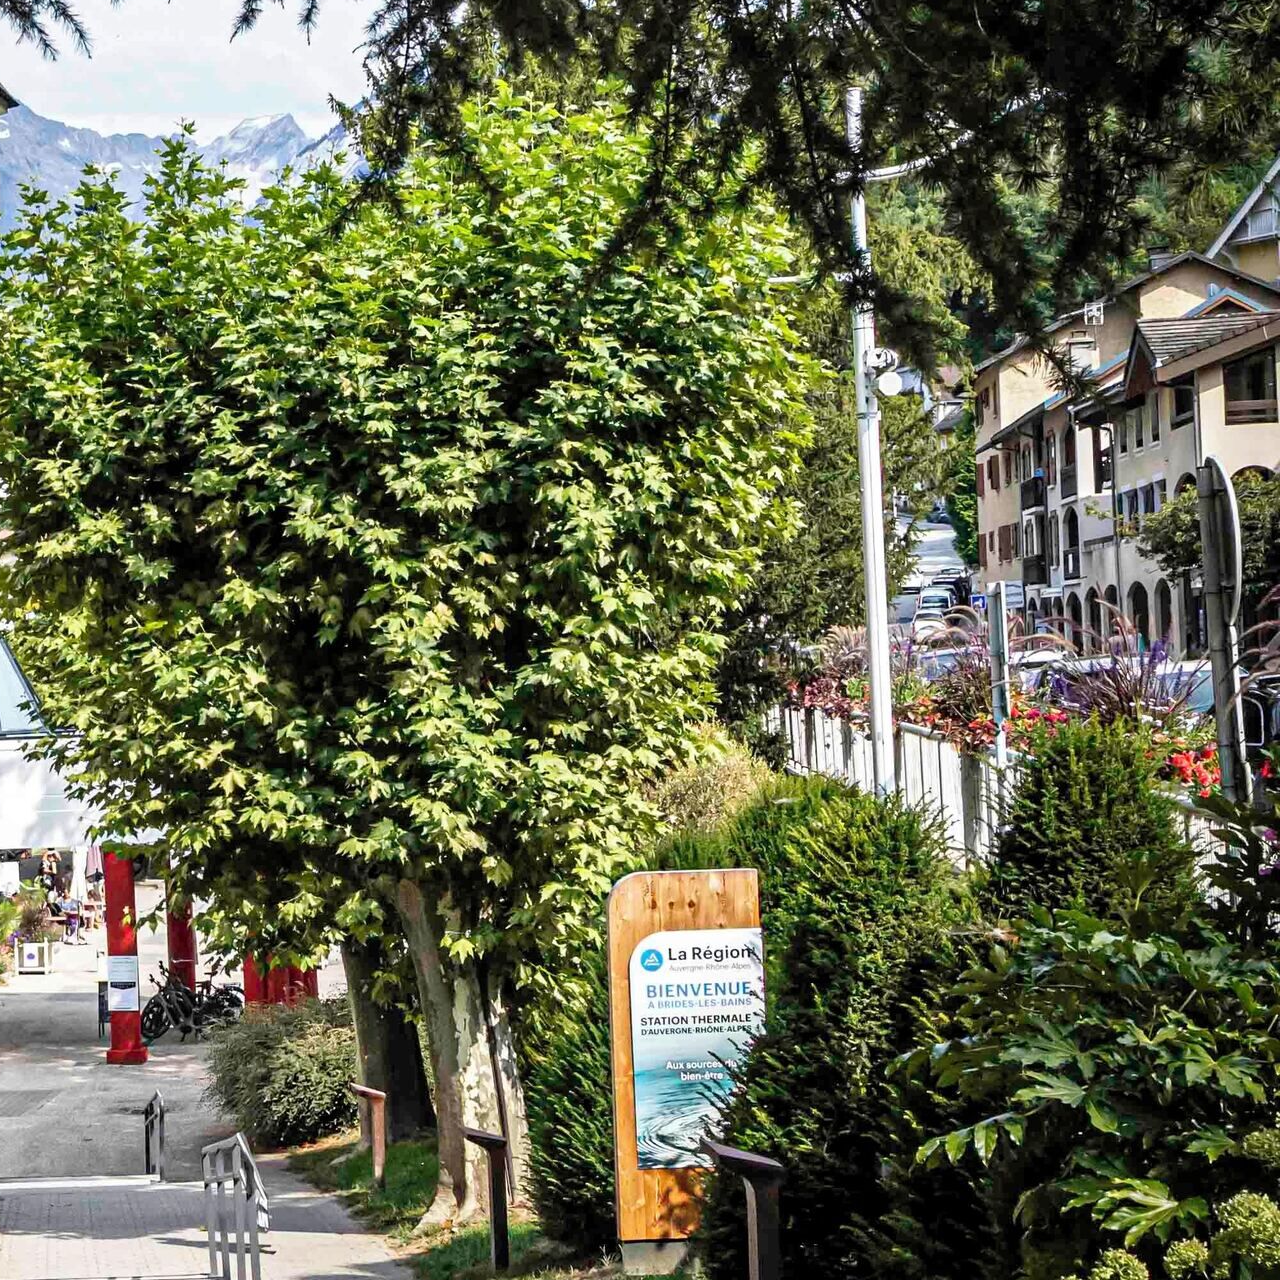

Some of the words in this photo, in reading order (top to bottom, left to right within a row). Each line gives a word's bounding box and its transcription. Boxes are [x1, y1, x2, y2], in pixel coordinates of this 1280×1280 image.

[668, 948, 687, 960] La
[692, 945, 751, 962] Région
[647, 982, 751, 998] BIENVENUE
[641, 1016, 688, 1026] STATION
[692, 1014, 751, 1024] THERMALE
[666, 1061, 685, 1069] Aux
[687, 1061, 722, 1069] sources
[681, 1071, 723, 1080] bien-être
